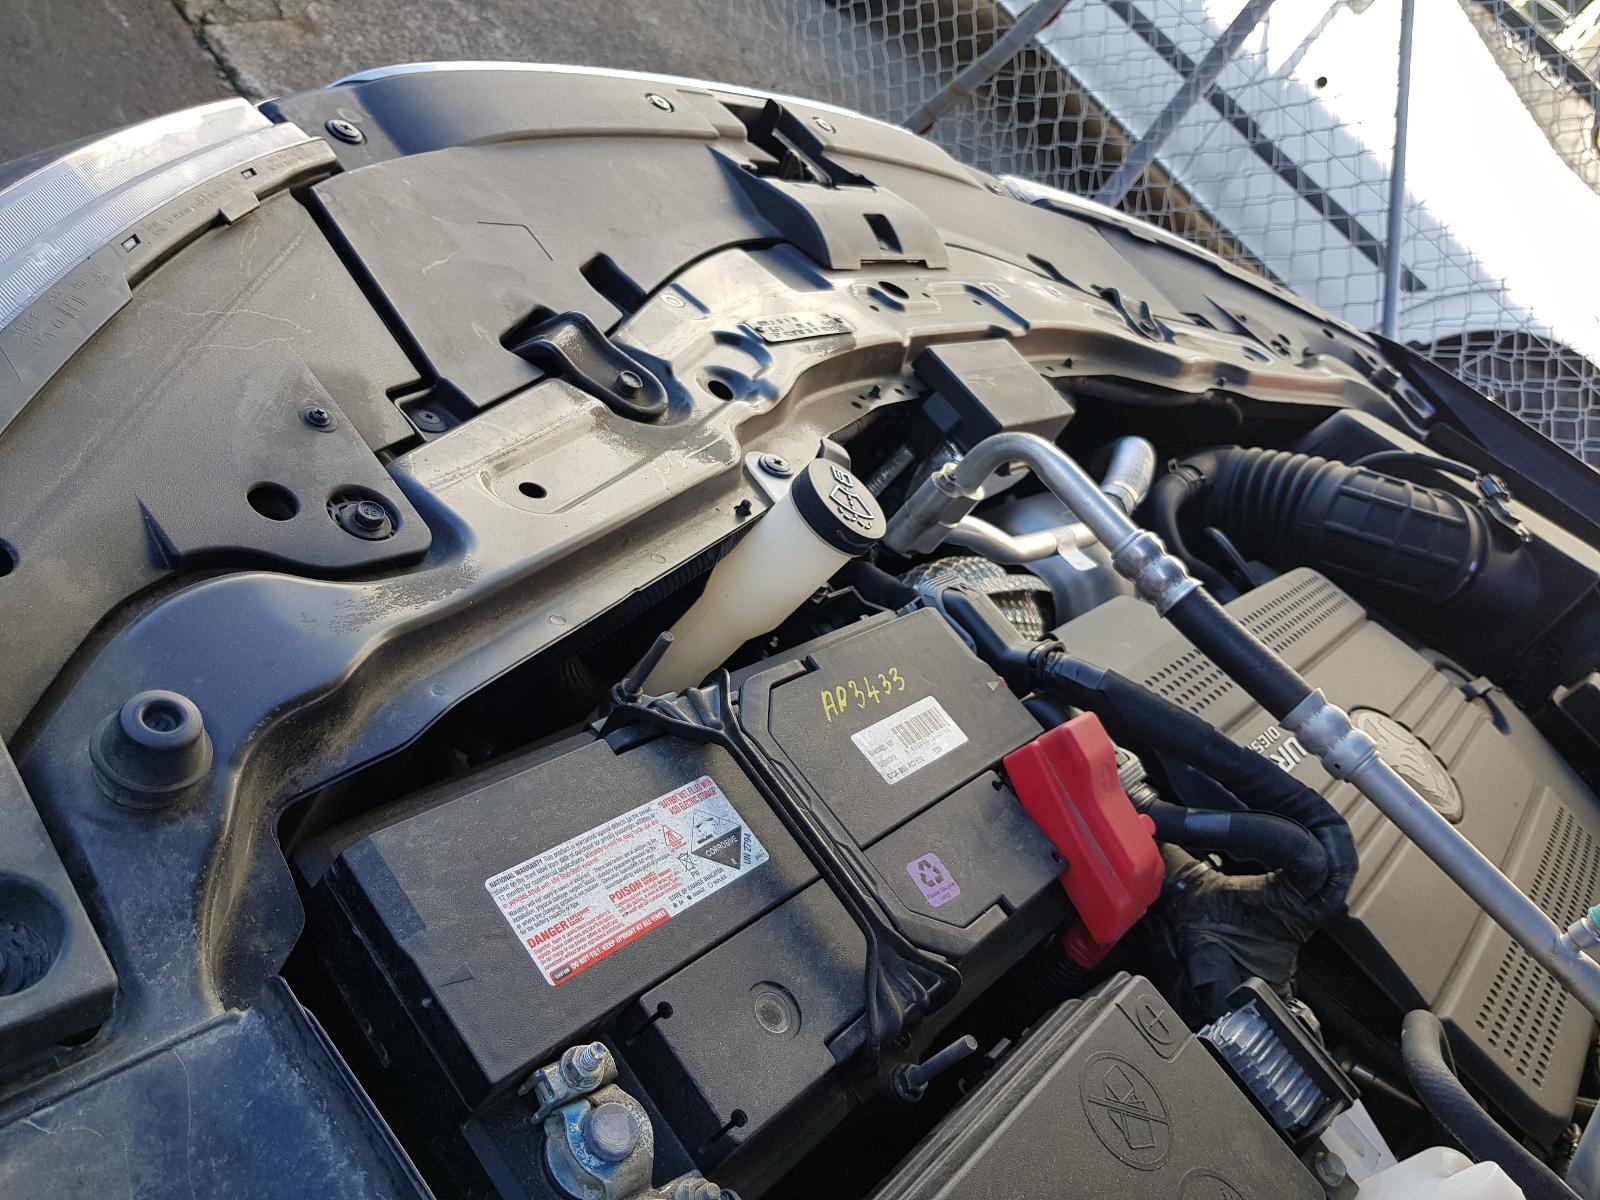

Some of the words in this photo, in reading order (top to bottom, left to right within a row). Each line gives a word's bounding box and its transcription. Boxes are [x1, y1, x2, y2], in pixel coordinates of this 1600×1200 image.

[1248, 725, 1281, 754] DIES
[1269, 736, 1308, 773] UR
[704, 835, 739, 858] CORROSIVE
[743, 832, 753, 852] 2794
[608, 879, 644, 904] POISON
[668, 890, 682, 902] STATE
[686, 878, 706, 892] CHARGE
[525, 919, 570, 950] DANGER
[570, 960, 580, 969] DO
[578, 954, 592, 965] NOT
[602, 939, 617, 951] KEEP
[614, 928, 637, 944] UPRIGHT
[635, 923, 644, 932] AT
[642, 918, 653, 928] ALL
[650, 910, 666, 922] TIMES
